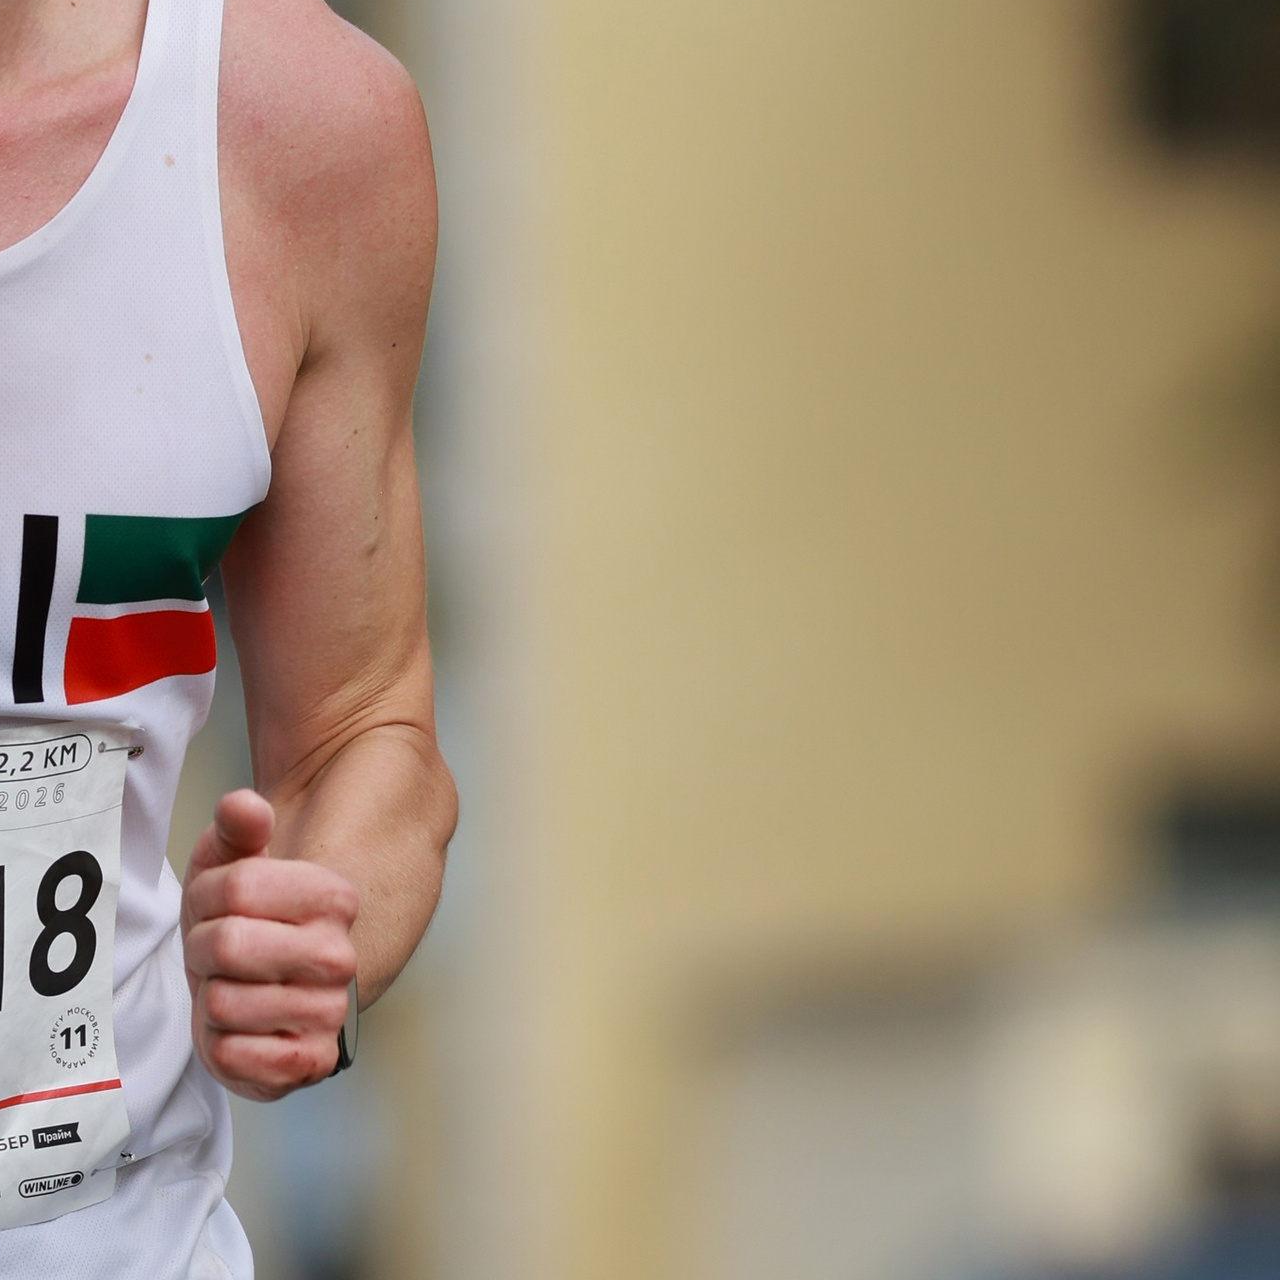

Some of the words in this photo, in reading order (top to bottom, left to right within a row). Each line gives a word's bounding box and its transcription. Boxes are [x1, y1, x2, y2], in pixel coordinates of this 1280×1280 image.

[60, 1024, 86, 1050] 11
[67, 1006, 100, 1058] МОСКОВСКИЙ
[49, 1043, 87, 1069] МАРАФОН
[37, 1127, 72, 1145] Прайм
[24, 1176, 71, 1194] WINLINE
